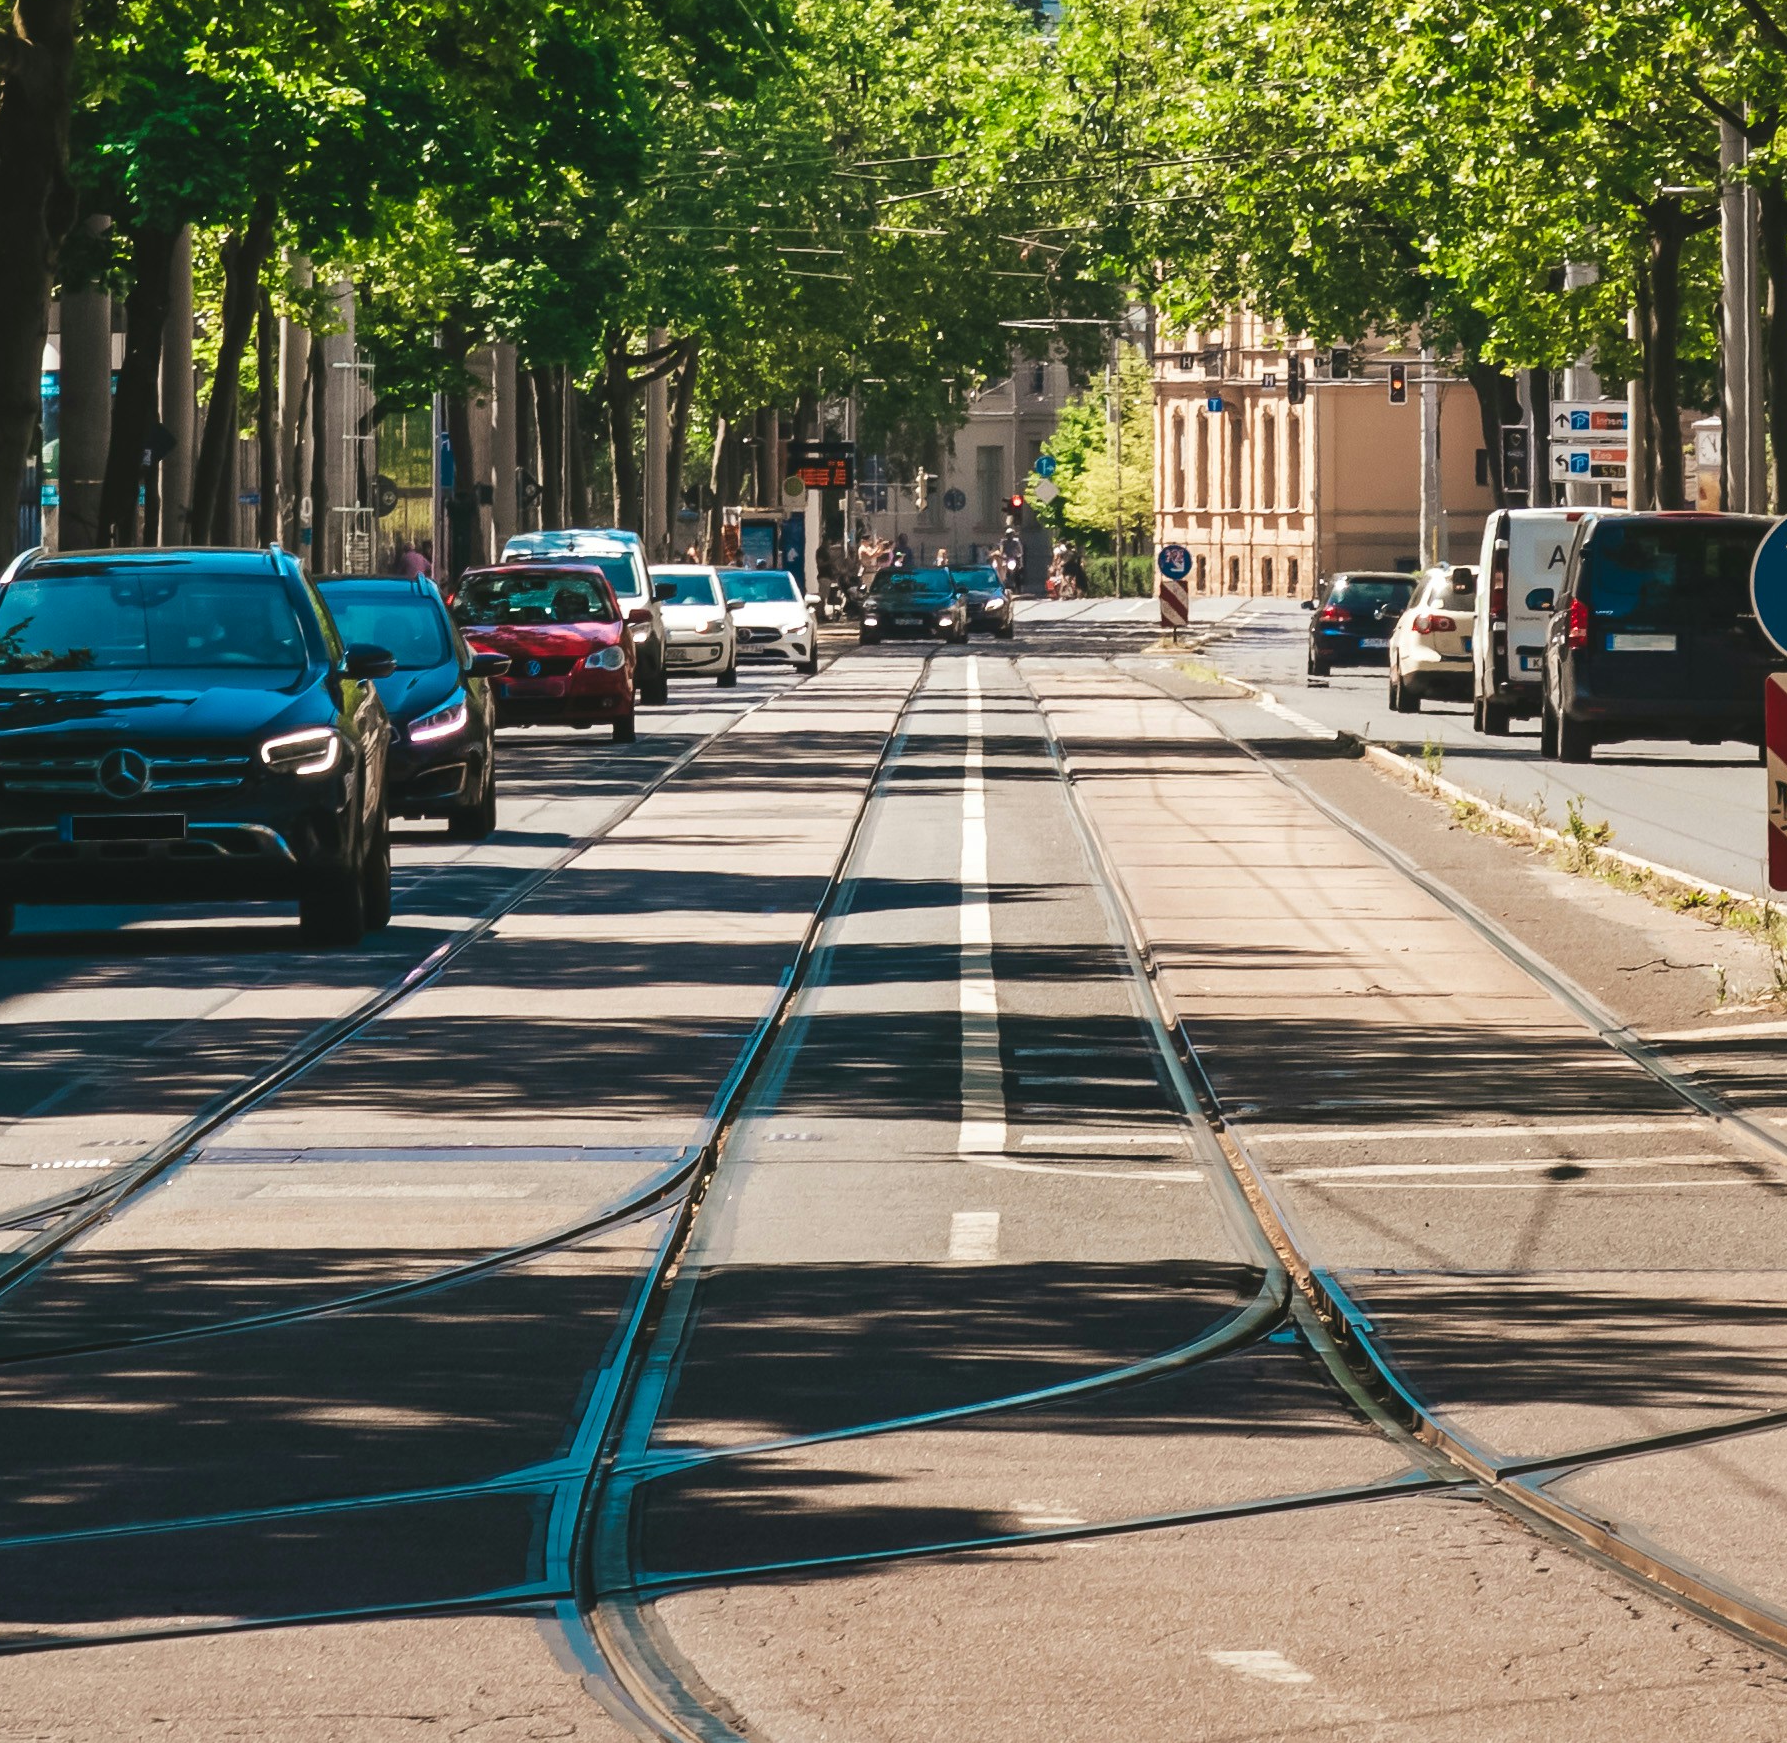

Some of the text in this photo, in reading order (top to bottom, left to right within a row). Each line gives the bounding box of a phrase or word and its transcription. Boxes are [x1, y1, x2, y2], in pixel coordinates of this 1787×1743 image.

[1182, 356, 1192, 368] H
[1210, 398, 1219, 411] T
[1548, 544, 1567, 570] A
